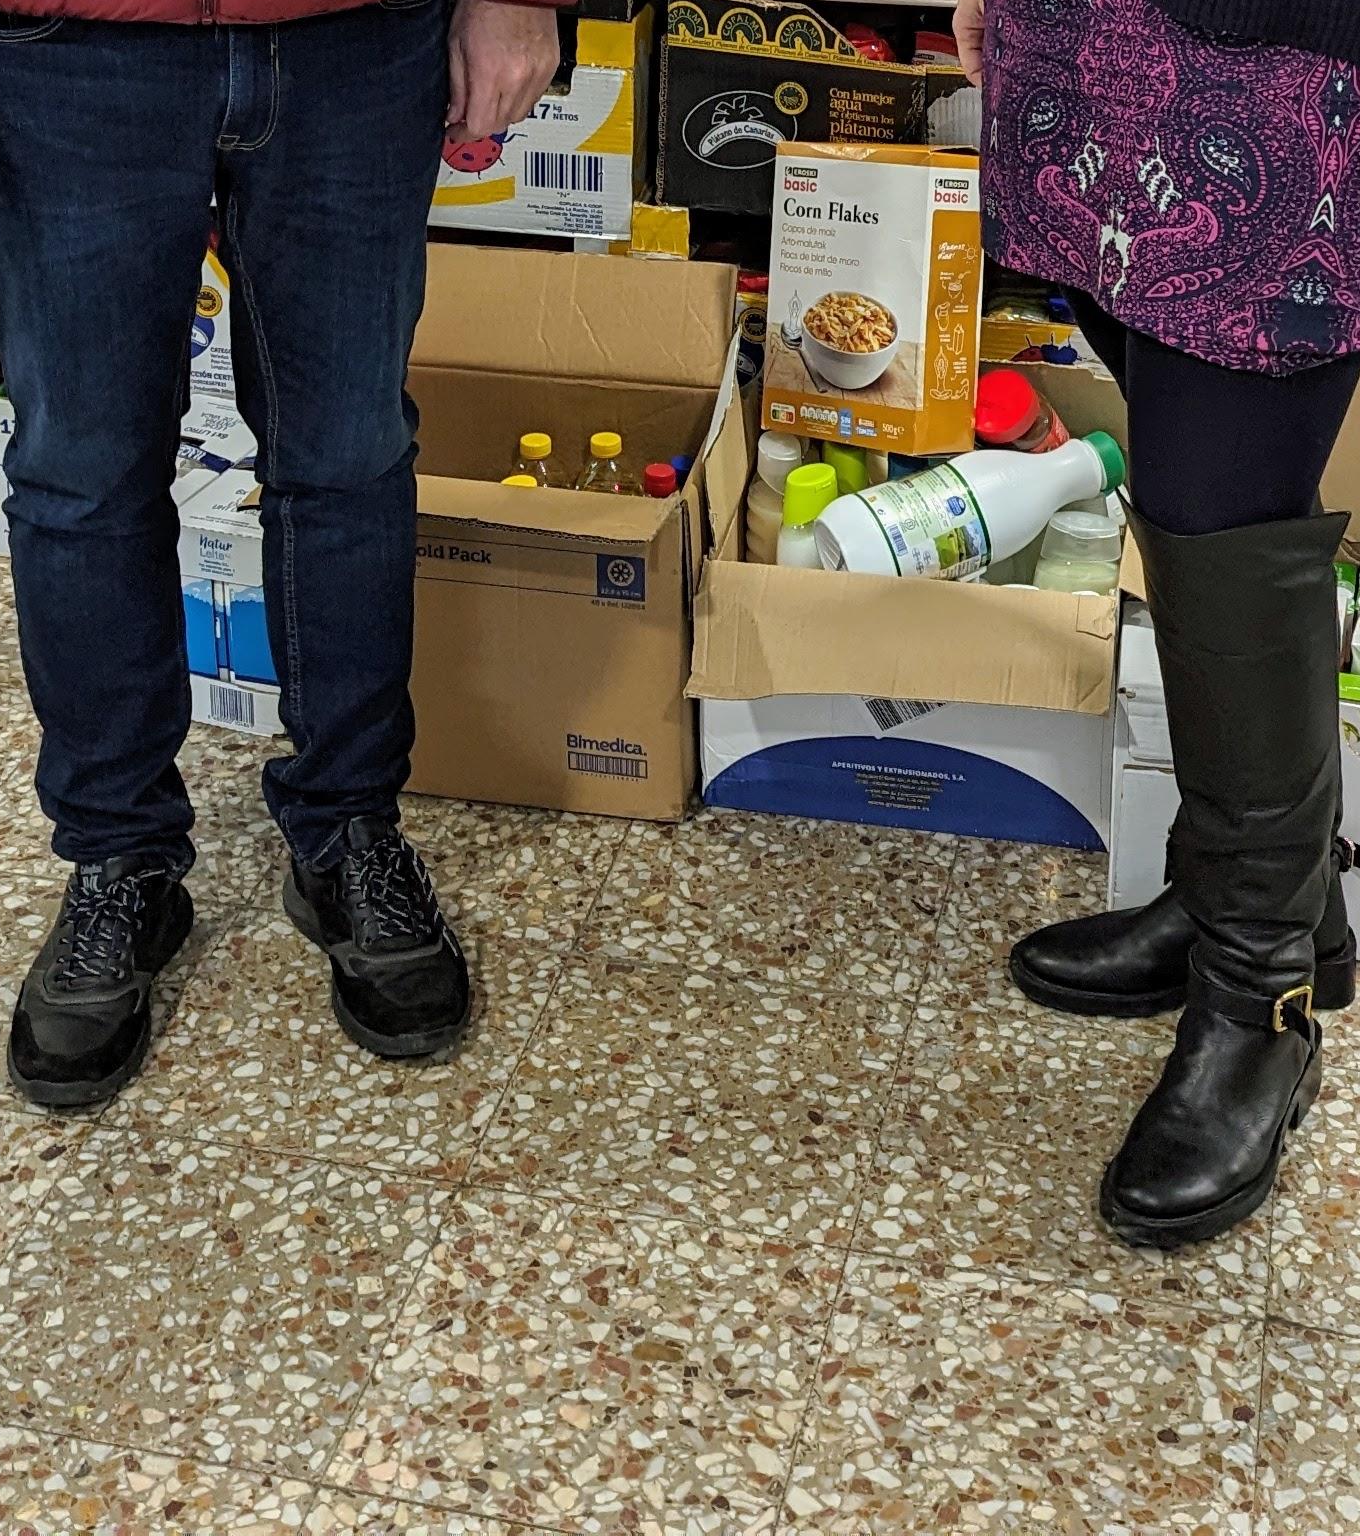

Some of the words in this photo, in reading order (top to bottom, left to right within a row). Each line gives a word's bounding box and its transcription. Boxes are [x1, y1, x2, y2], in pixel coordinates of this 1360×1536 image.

[723, 14, 761, 40] COPALMA
[781, 21, 820, 47] COPALMA
[829, 88, 850, 99] Con
[553, 104, 562, 113] kg
[830, 98, 862, 112] agua
[553, 113, 578, 121] NETOS
[708, 129, 733, 146] Plátano
[734, 126, 743, 134] de
[744, 125, 775, 140] Canarias
[830, 119, 894, 140] plátanos
[794, 168, 817, 177] EROSKI
[783, 177, 817, 193] basic
[945, 180, 968, 189] EROSKI
[934, 190, 969, 204] basic
[783, 197, 822, 220] Corn
[828, 202, 880, 225] Flakes
[782, 222, 805, 234] Copos
[807, 226, 817, 235] de
[800, 252, 809, 261] de
[811, 253, 825, 263] blat
[827, 255, 837, 264] de
[804, 266, 813, 275] de
[200, 534, 232, 551] Natur
[417, 543, 444, 559] old
[448, 546, 491, 564] Pack
[832, 761, 876, 772] APERITIVOS
